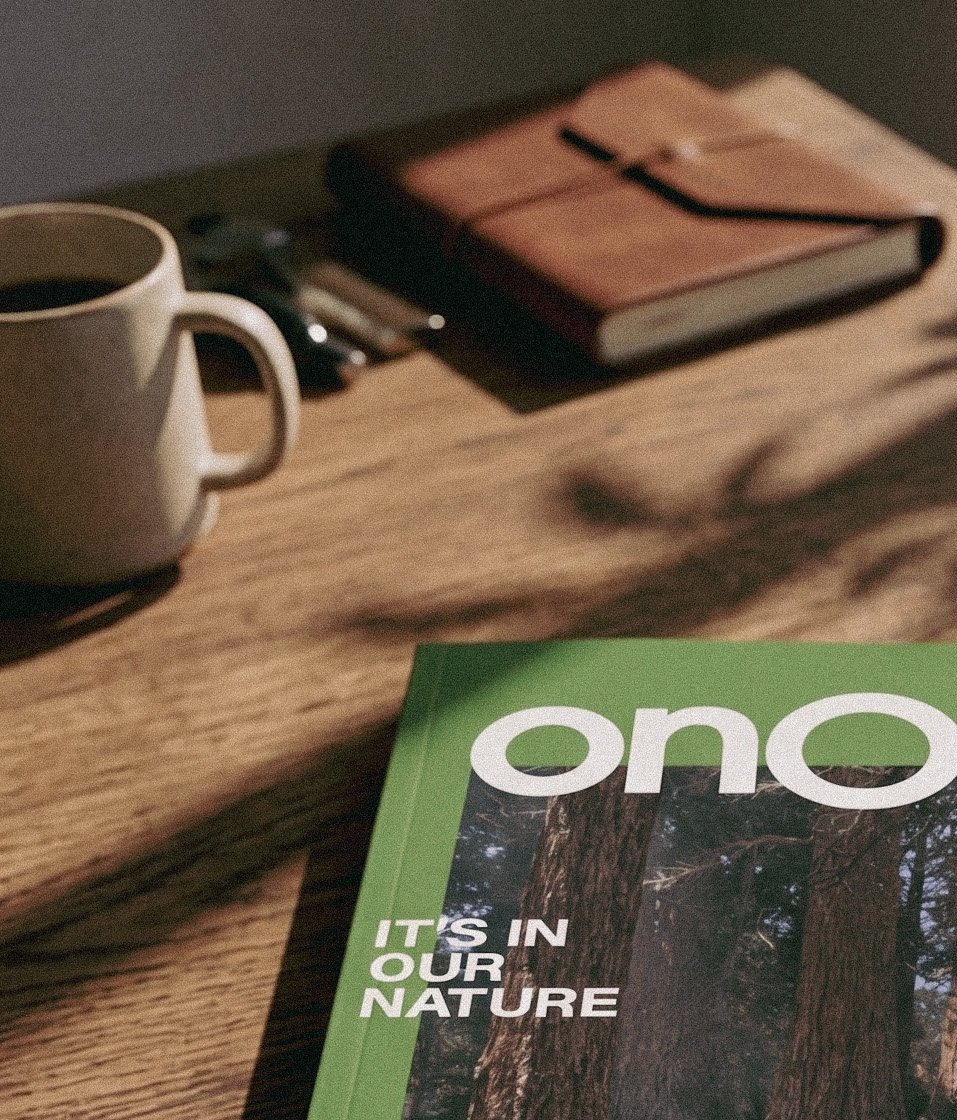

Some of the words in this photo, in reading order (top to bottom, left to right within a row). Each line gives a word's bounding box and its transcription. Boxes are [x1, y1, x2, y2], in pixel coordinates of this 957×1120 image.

[374, 918, 488, 948] IT'S
[507, 918, 569, 947] IN
[369, 952, 505, 982] OUR
[359, 987, 620, 1018] NATURE
